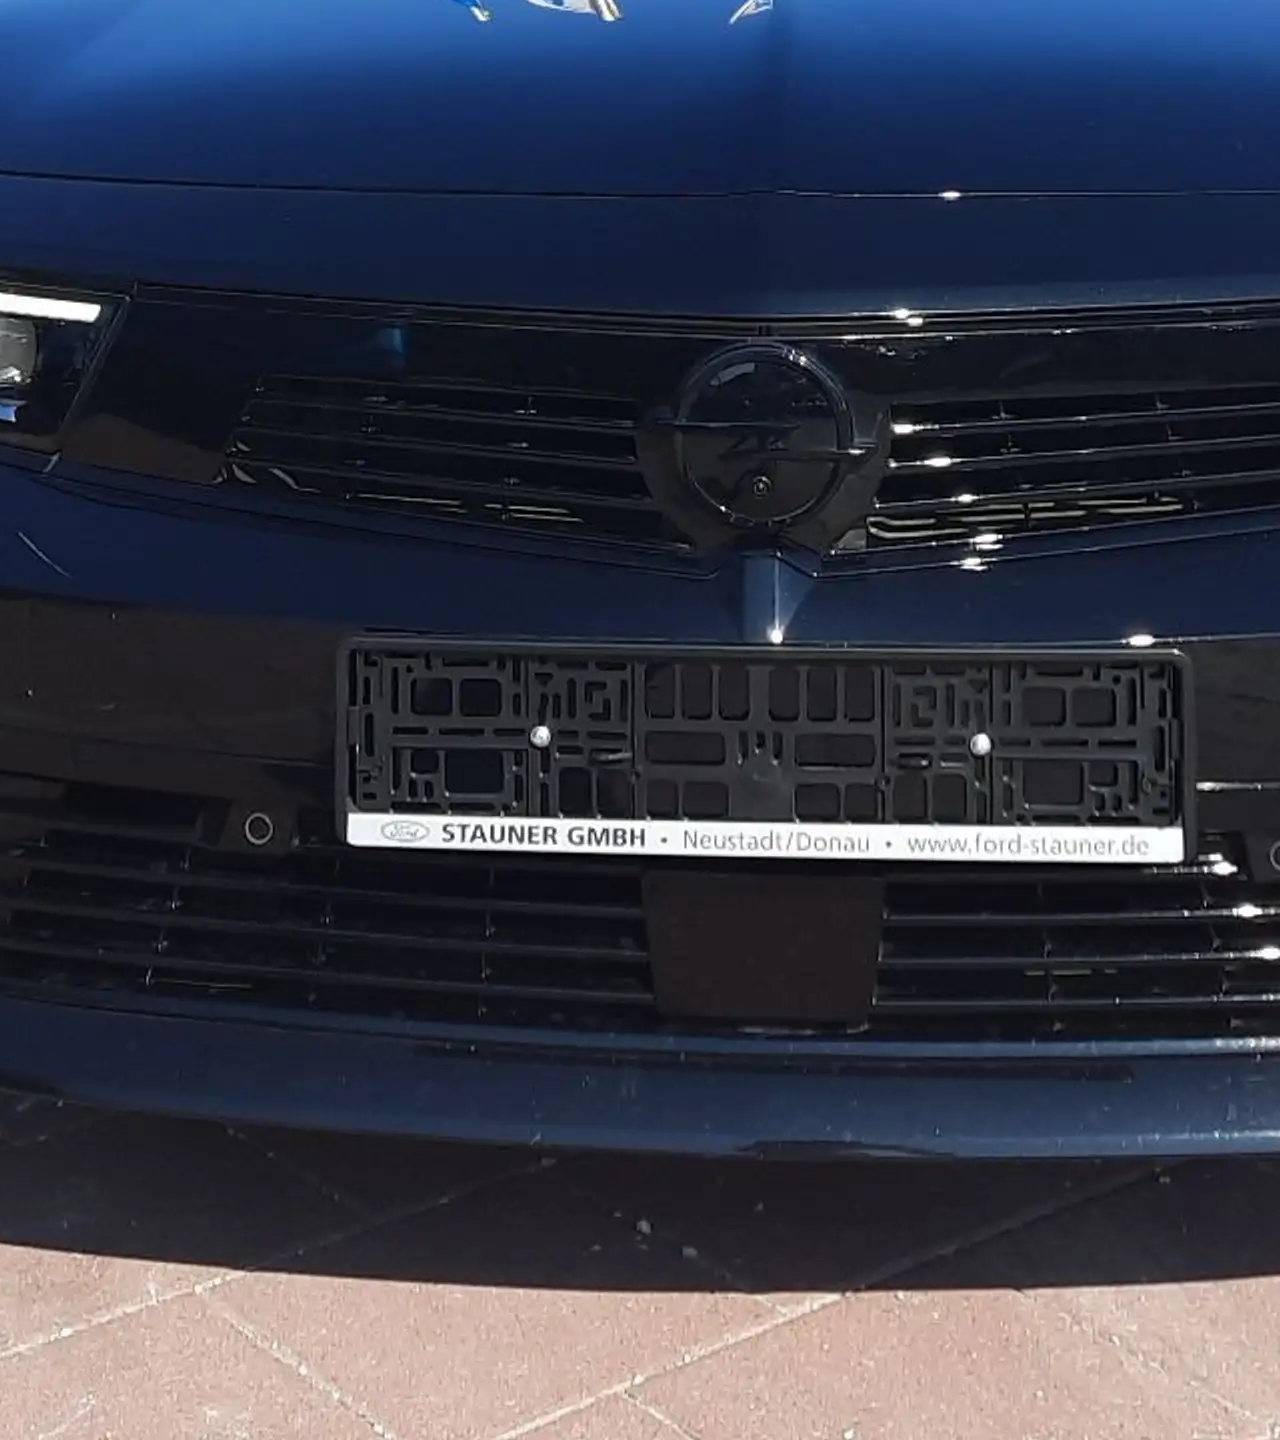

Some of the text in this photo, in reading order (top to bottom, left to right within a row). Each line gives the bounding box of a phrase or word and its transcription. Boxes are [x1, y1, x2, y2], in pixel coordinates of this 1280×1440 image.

[441, 823, 558, 845] STAUNER
[567, 826, 646, 847] GMBH
[683, 830, 870, 853] Neustadt/Donau
[907, 832, 1150, 857] www.ford-stauner.de
